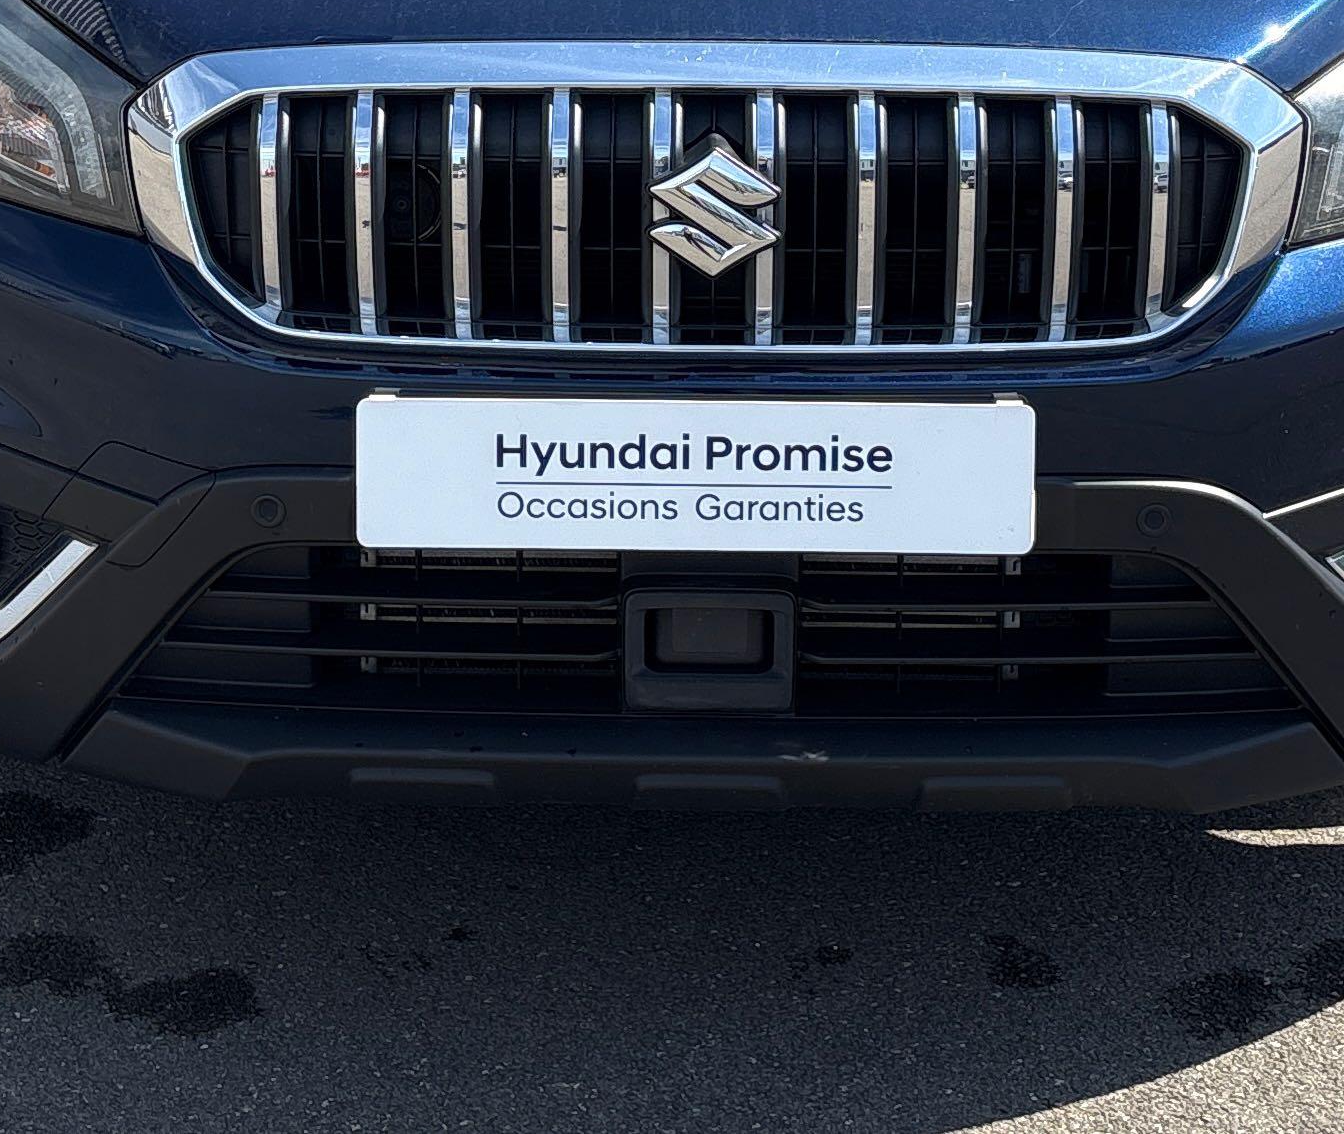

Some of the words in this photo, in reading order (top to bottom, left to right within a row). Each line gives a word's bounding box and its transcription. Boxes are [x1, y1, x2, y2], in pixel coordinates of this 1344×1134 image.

[495, 432, 691, 477] Hyundai
[704, 433, 894, 473] Promise
[496, 490, 679, 522] Occasions
[694, 492, 865, 523] Garanties
